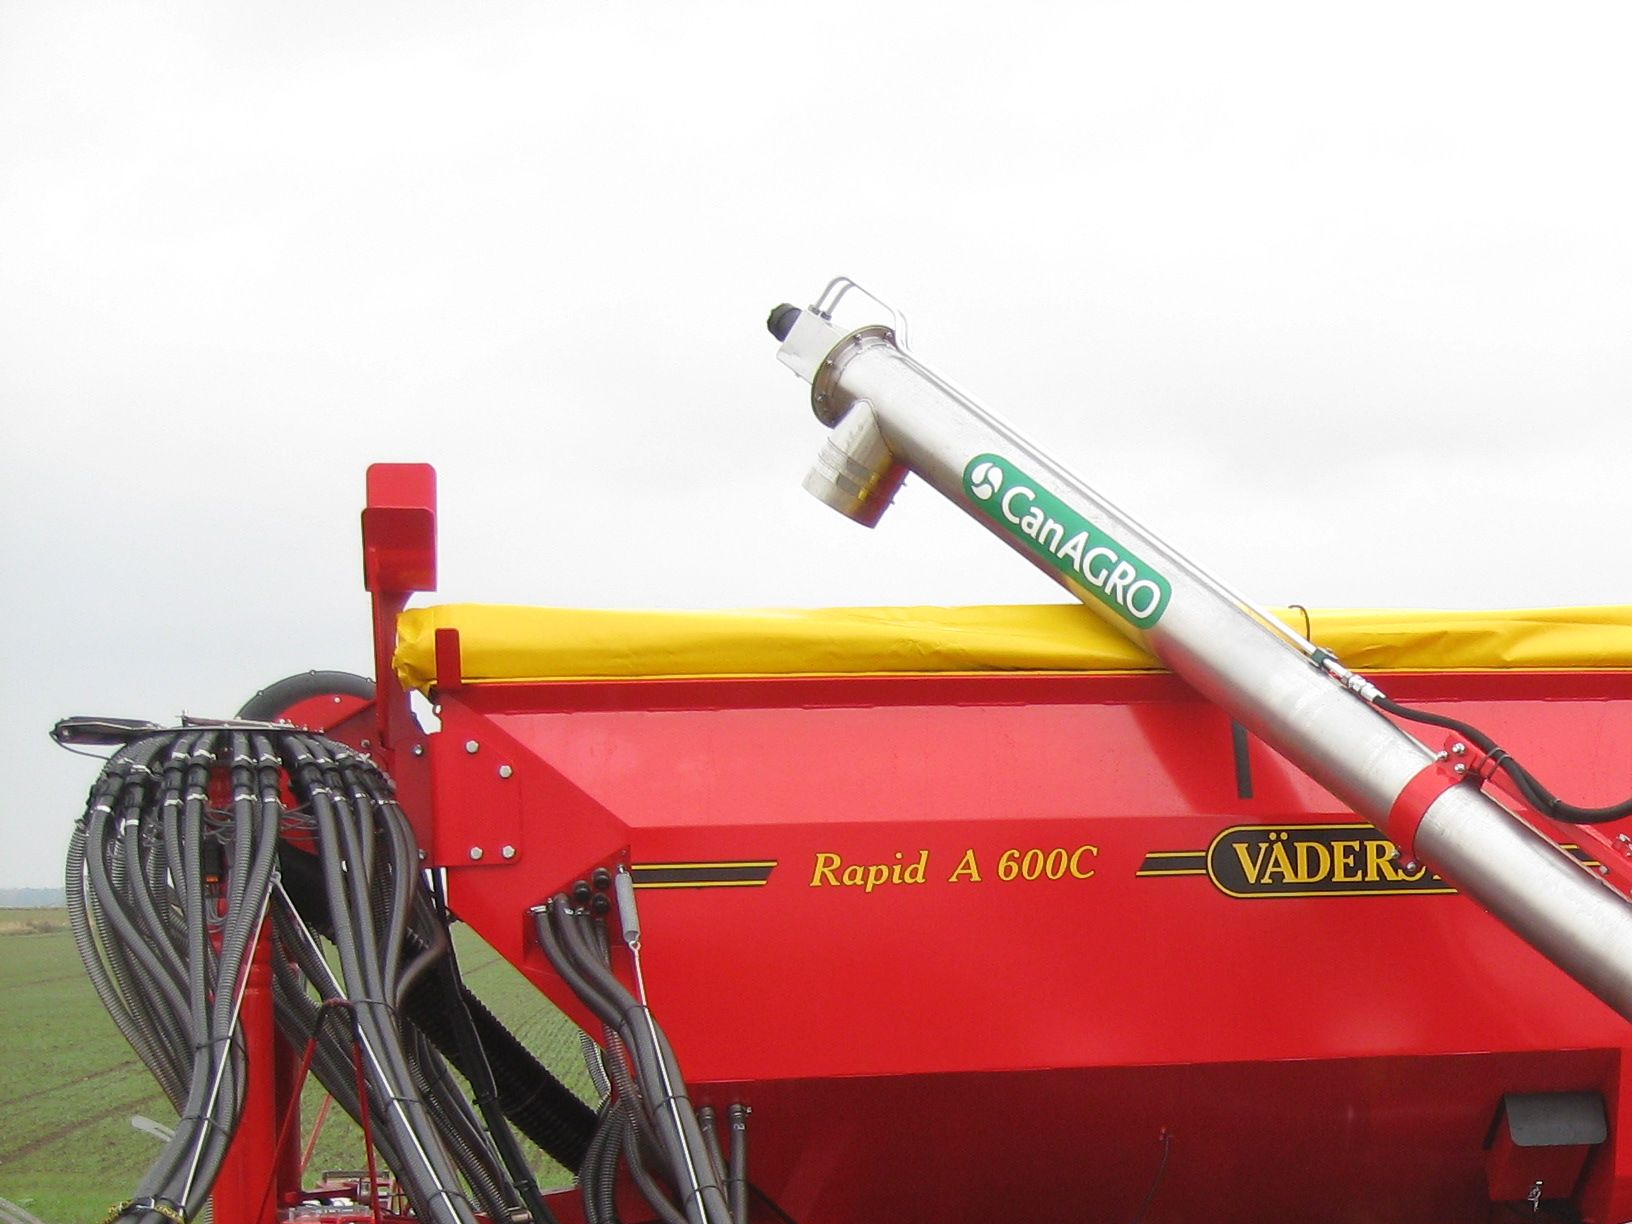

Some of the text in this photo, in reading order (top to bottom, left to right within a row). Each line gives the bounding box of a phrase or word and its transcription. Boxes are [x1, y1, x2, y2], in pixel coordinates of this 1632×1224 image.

[1001, 485, 1162, 619] CanAGRO
[809, 844, 1099, 893] Rapid A 600C
[1231, 831, 1441, 884] VÄDER
